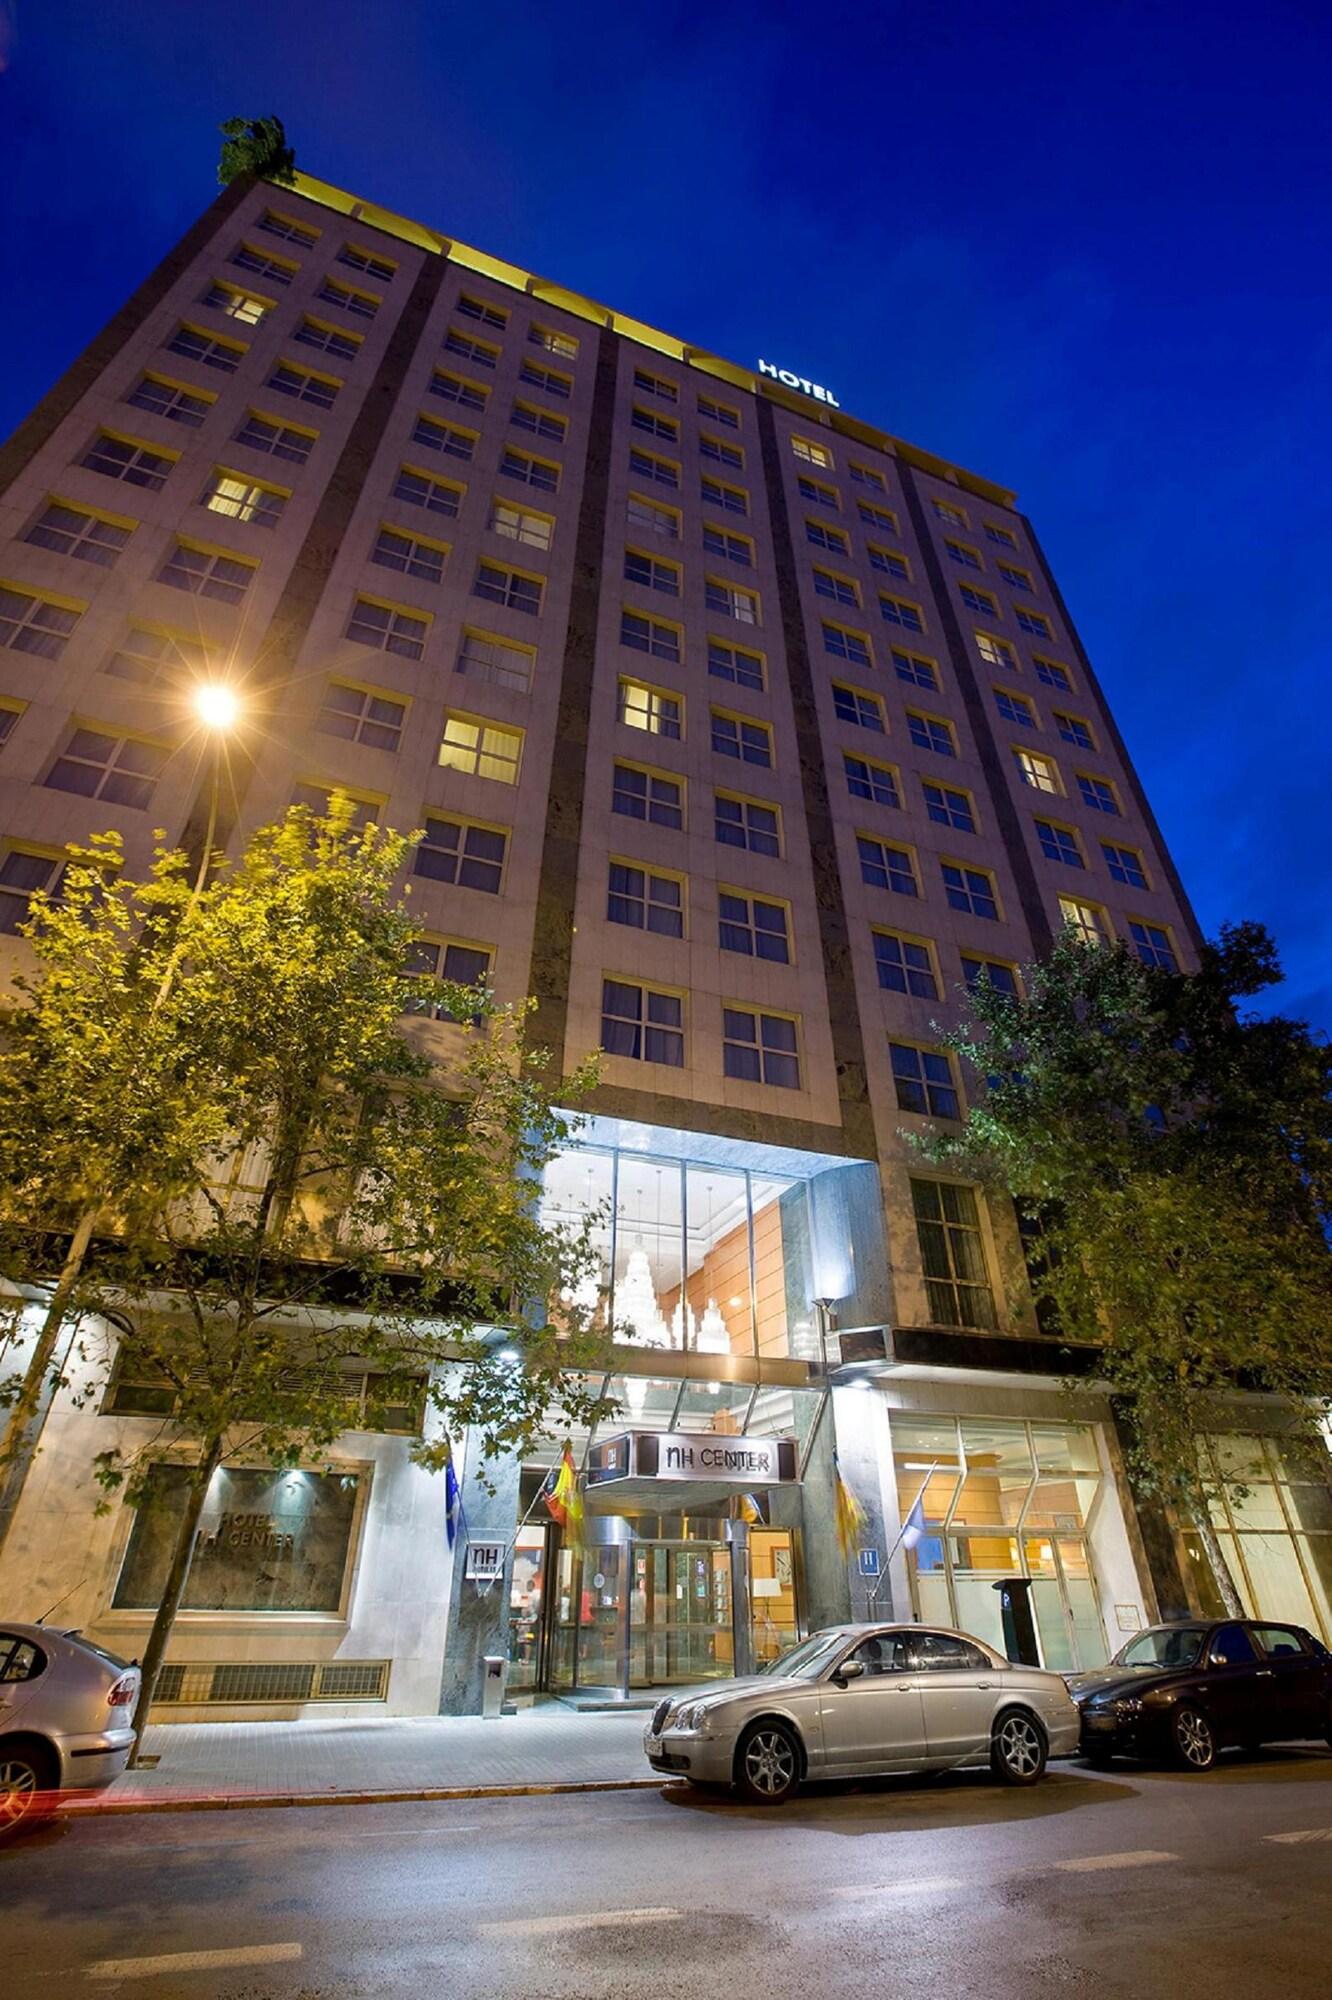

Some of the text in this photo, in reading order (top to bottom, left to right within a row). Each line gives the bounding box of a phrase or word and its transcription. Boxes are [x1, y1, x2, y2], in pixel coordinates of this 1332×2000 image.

[758, 359, 840, 408] HOTEL
[701, 1447, 770, 1472] CENTER
[220, 1512, 276, 1528] HOTEL
[230, 1530, 294, 1548] CENTER
